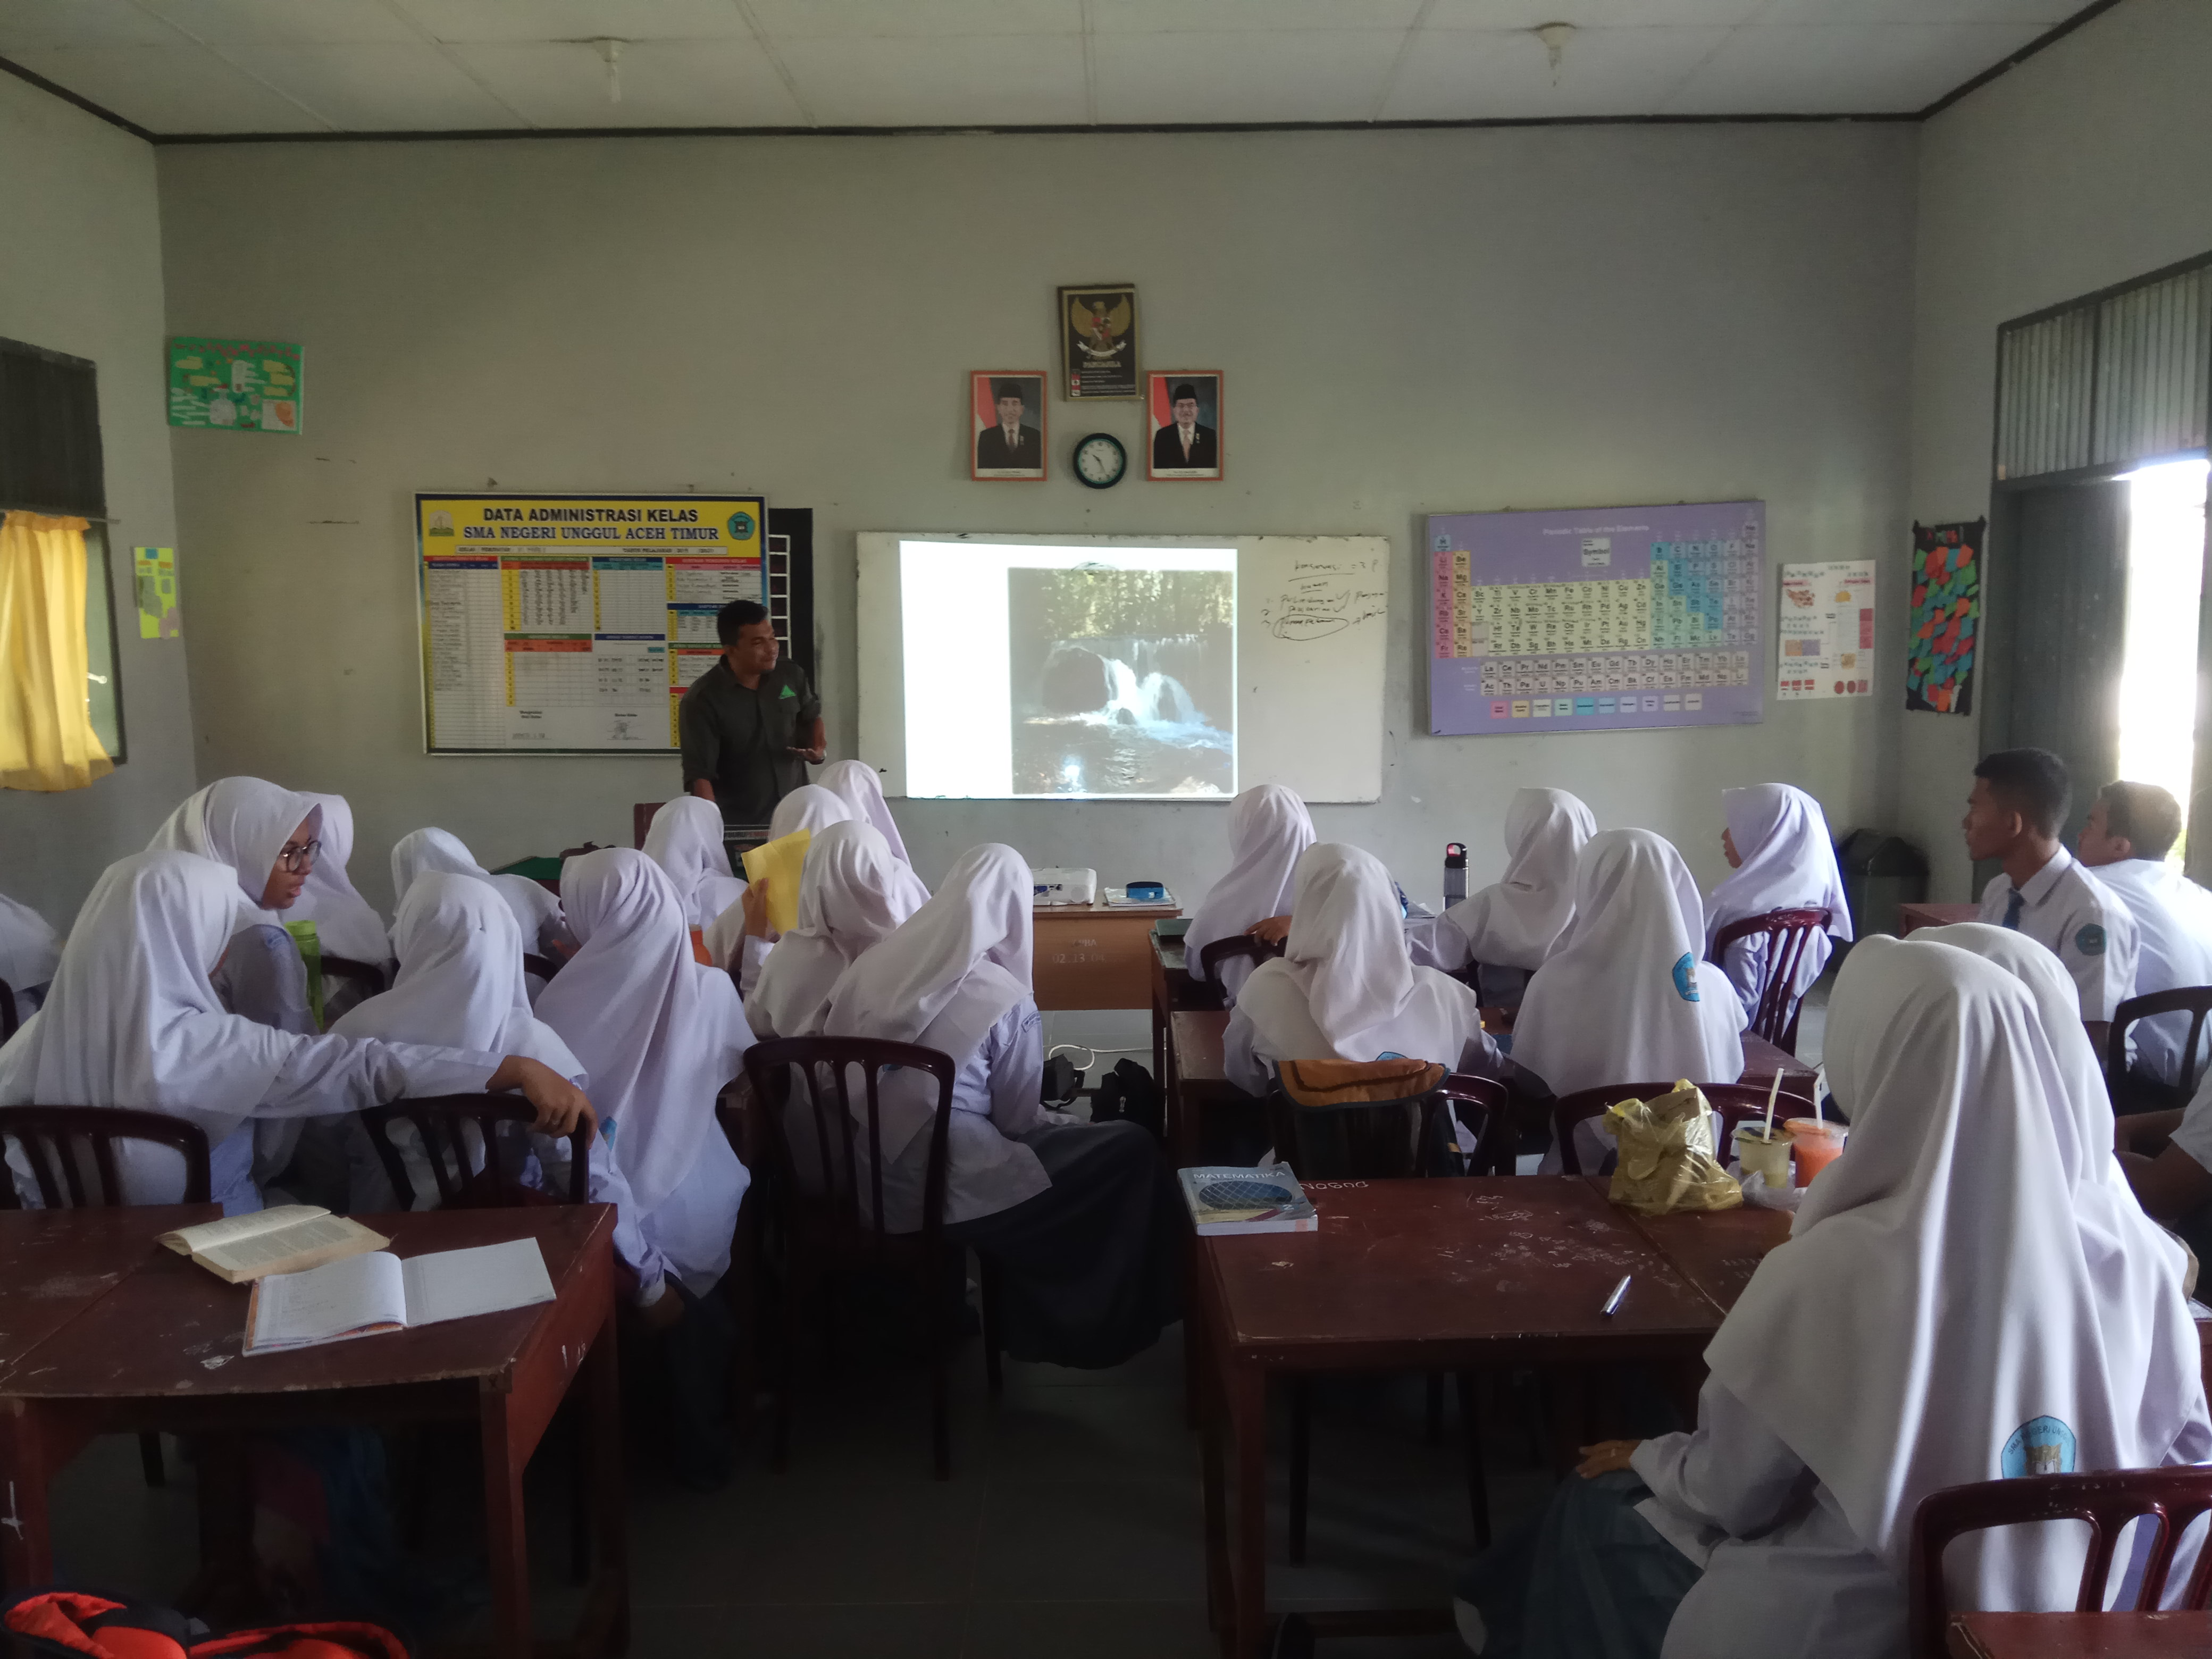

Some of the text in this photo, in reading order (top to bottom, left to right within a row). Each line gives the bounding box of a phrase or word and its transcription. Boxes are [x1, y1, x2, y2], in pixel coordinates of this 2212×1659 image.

[483, 508, 698, 522] DATA ADMINISTRASI KELAS
[463, 526, 719, 540] SMA NEGERI UNGGUL ACEH TIMUR
[1583, 548, 1610, 556] Symbol
[1193, 1171, 1285, 1179] MATEMATIKA
[2008, 1438, 2021, 1455] SMA
